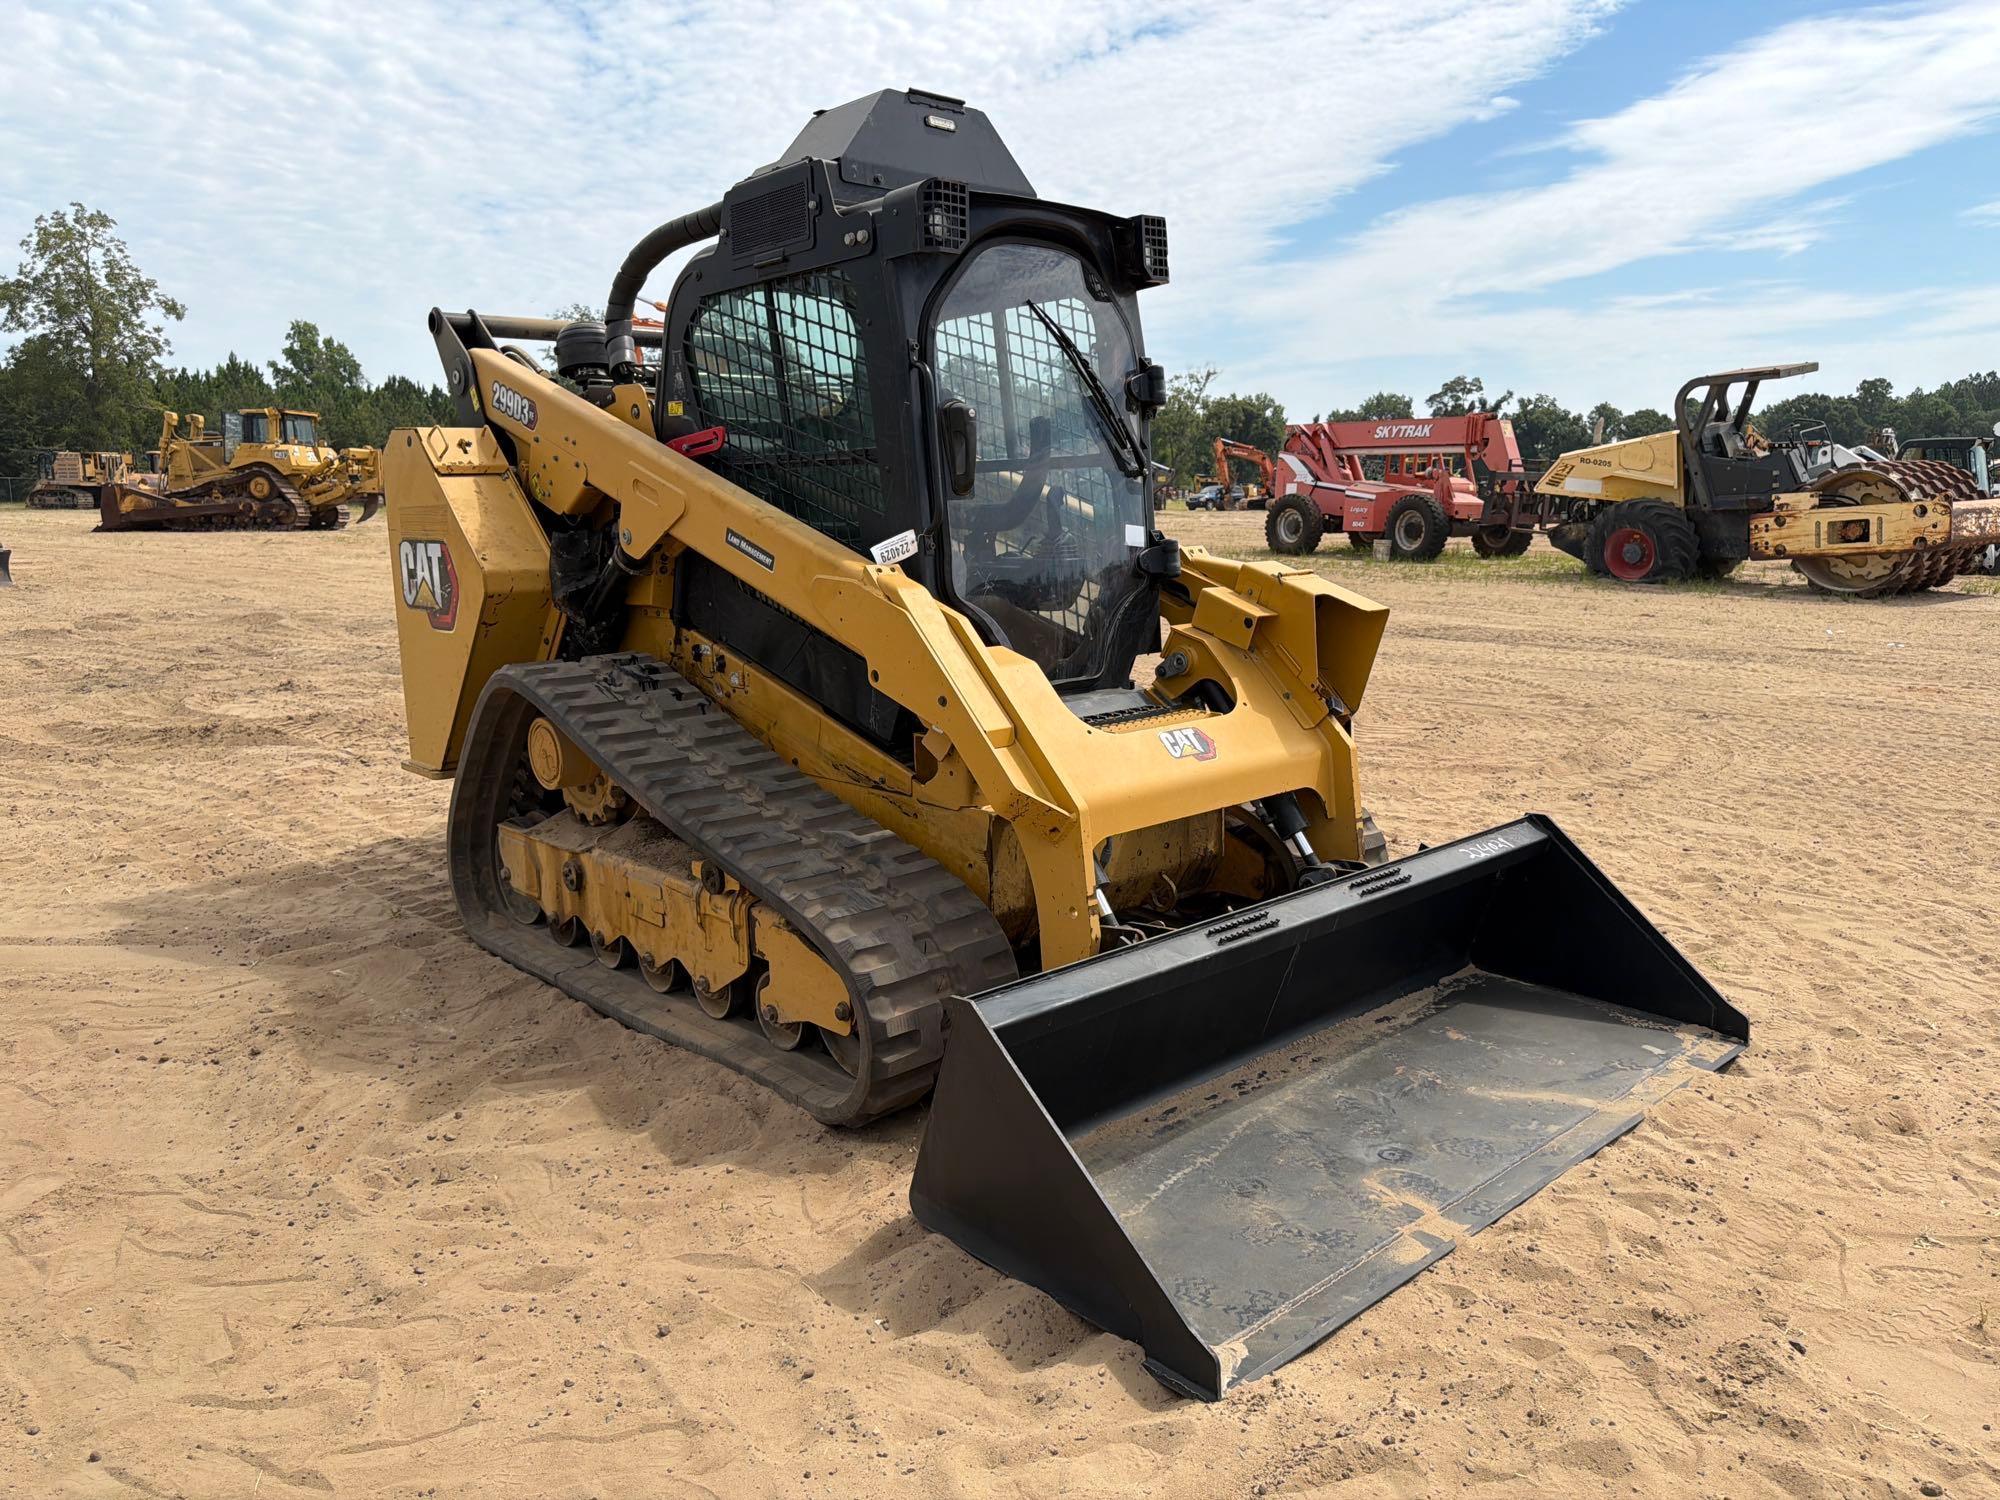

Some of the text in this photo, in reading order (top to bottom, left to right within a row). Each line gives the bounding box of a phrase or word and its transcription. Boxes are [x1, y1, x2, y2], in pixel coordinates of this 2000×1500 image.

[492, 381, 529, 425] 299D3
[1374, 424, 1433, 439] SKYTRAK
[1350, 506, 1368, 514] Legacy
[880, 541, 911, 563] 224029
[400, 541, 443, 609] CAT
[1159, 728, 1205, 758] CAT
